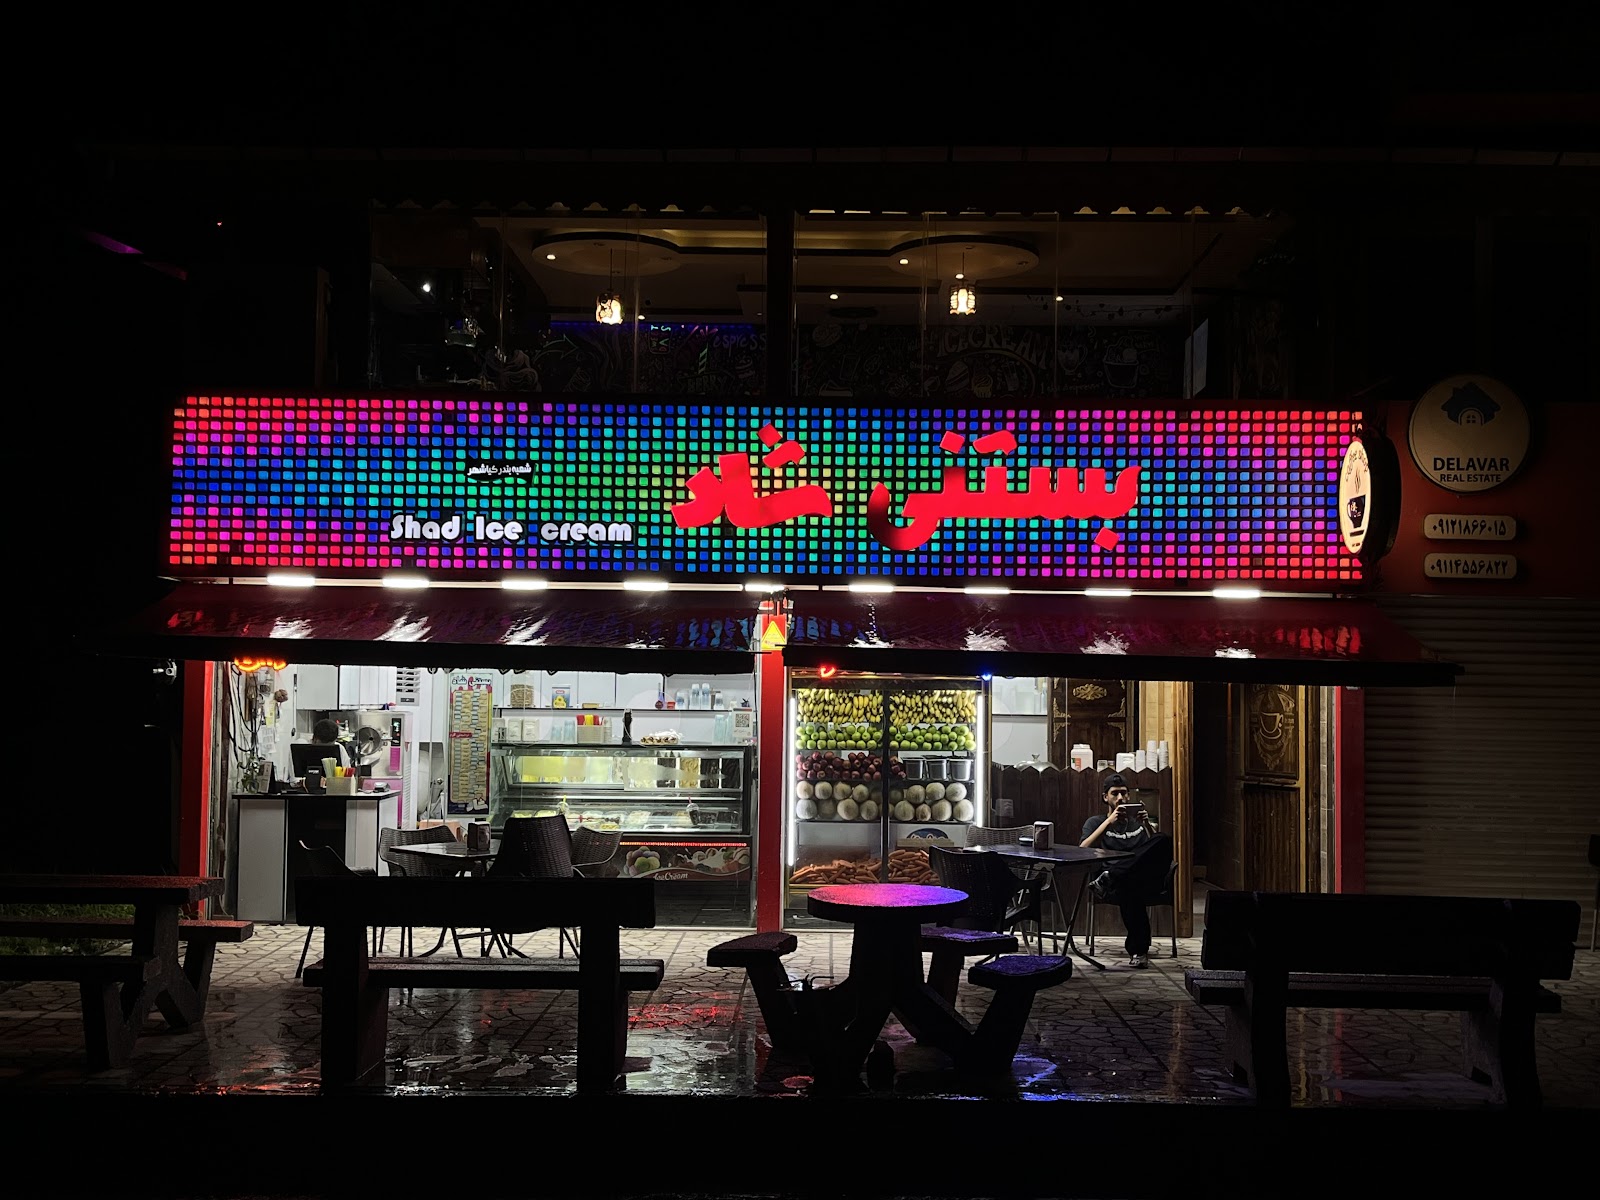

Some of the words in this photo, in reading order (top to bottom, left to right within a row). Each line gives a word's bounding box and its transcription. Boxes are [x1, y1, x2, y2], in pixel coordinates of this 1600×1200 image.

[467, 463, 498, 476] کیاشهر
[498, 464, 512, 476] بندر
[512, 462, 532, 476] شعبه
[1433, 457, 1510, 471] DELAVAR
[670, 423, 833, 529] شاد
[1440, 473, 1464, 483] REAL
[1467, 473, 1501, 483] ESTATE
[867, 430, 1142, 551] بستنی
[390, 513, 461, 540] Shad
[475, 514, 523, 541] Ice
[540, 521, 633, 542] cream
